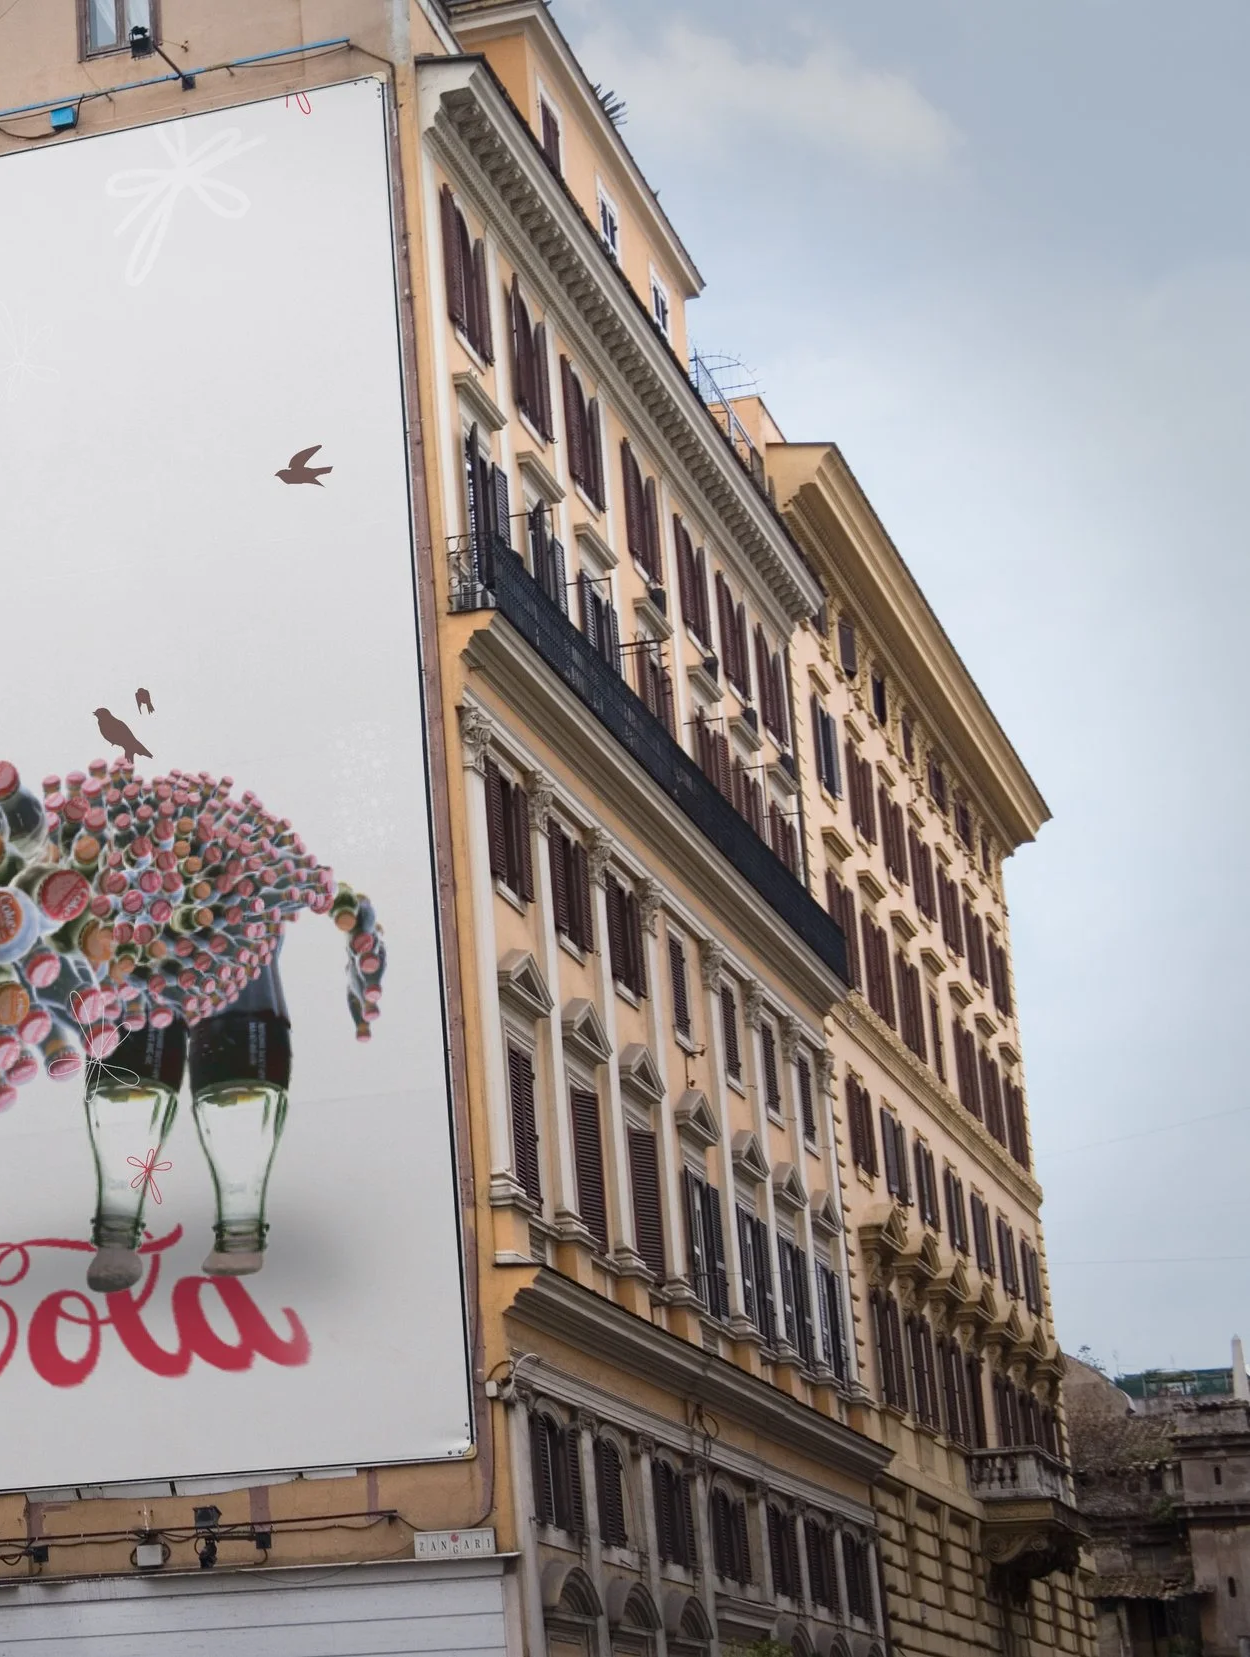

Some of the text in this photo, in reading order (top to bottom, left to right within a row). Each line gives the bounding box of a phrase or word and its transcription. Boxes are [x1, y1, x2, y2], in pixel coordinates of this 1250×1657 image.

[0, 895, 17, 936] Coke
[61, 887, 88, 919] Coke
[419, 1538, 491, 1554] ZANGARI
